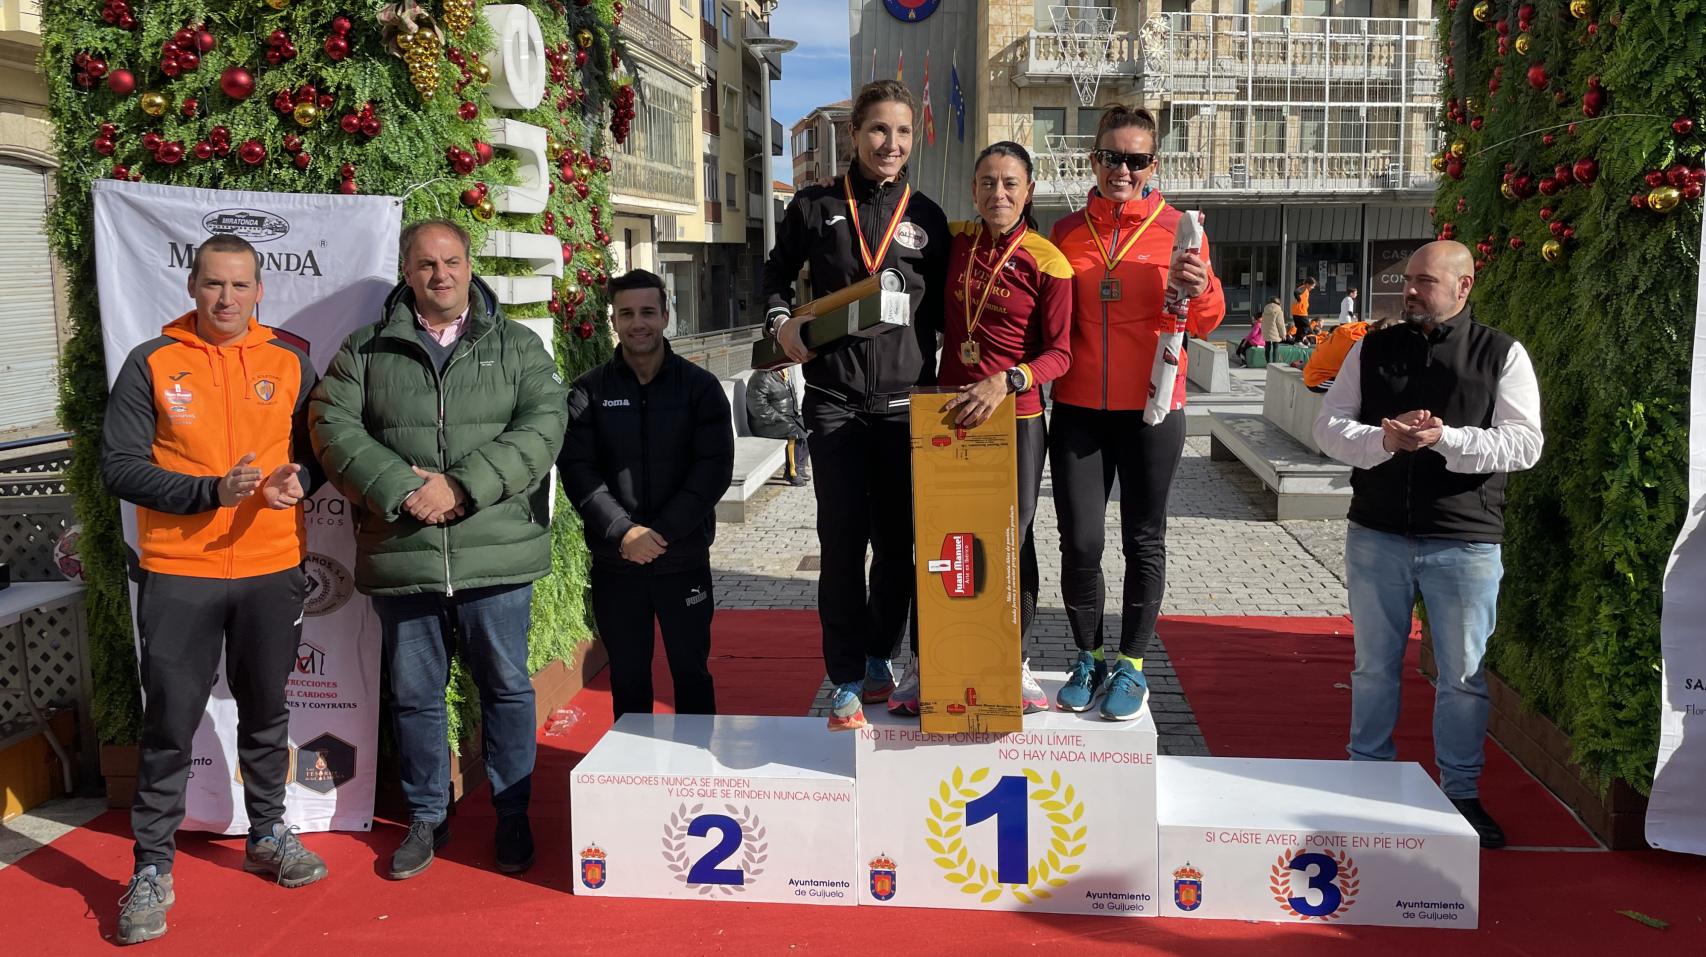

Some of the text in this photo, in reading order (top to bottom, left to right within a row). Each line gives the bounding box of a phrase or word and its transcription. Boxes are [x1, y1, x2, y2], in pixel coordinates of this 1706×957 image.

[222, 217, 259, 226] MIRATONDA
[602, 398, 630, 407] Joma
[953, 535, 964, 594] Juan Manuel
[287, 679, 337, 688] TRUCCIONES
[297, 690, 337, 699] CARDOSO
[860, 729, 880, 741] NO
[884, 730, 896, 741] TE
[899, 730, 944, 743] PUEDES
[947, 732, 990, 744] PONER
[1047, 732, 1086, 748] LÍMITE,
[999, 749, 1153, 765] NO HAY NADA IMPOSIBLE
[577, 775, 750, 789] LOS GANADORES NUNCA SE RINDEN
[667, 788, 850, 802] Y LOS QUE SE RINDEN NUNCA GANAN
[965, 776, 1028, 884] 1
[1206, 829, 1425, 849] SI CAÍSTE AYER, PONTE EN PIE HOY
[686, 814, 745, 886] 2
[788, 878, 850, 888] Ayuntamiento
[1287, 852, 1342, 917] 3
[809, 889, 844, 899] Guijuelo
[1085, 890, 1151, 901] Ayuntamiento
[1092, 902, 1144, 912] de Guijuelo
[1395, 900, 1465, 910] Ayuntamiento
[1402, 911, 1458, 921] de Guijuelo
